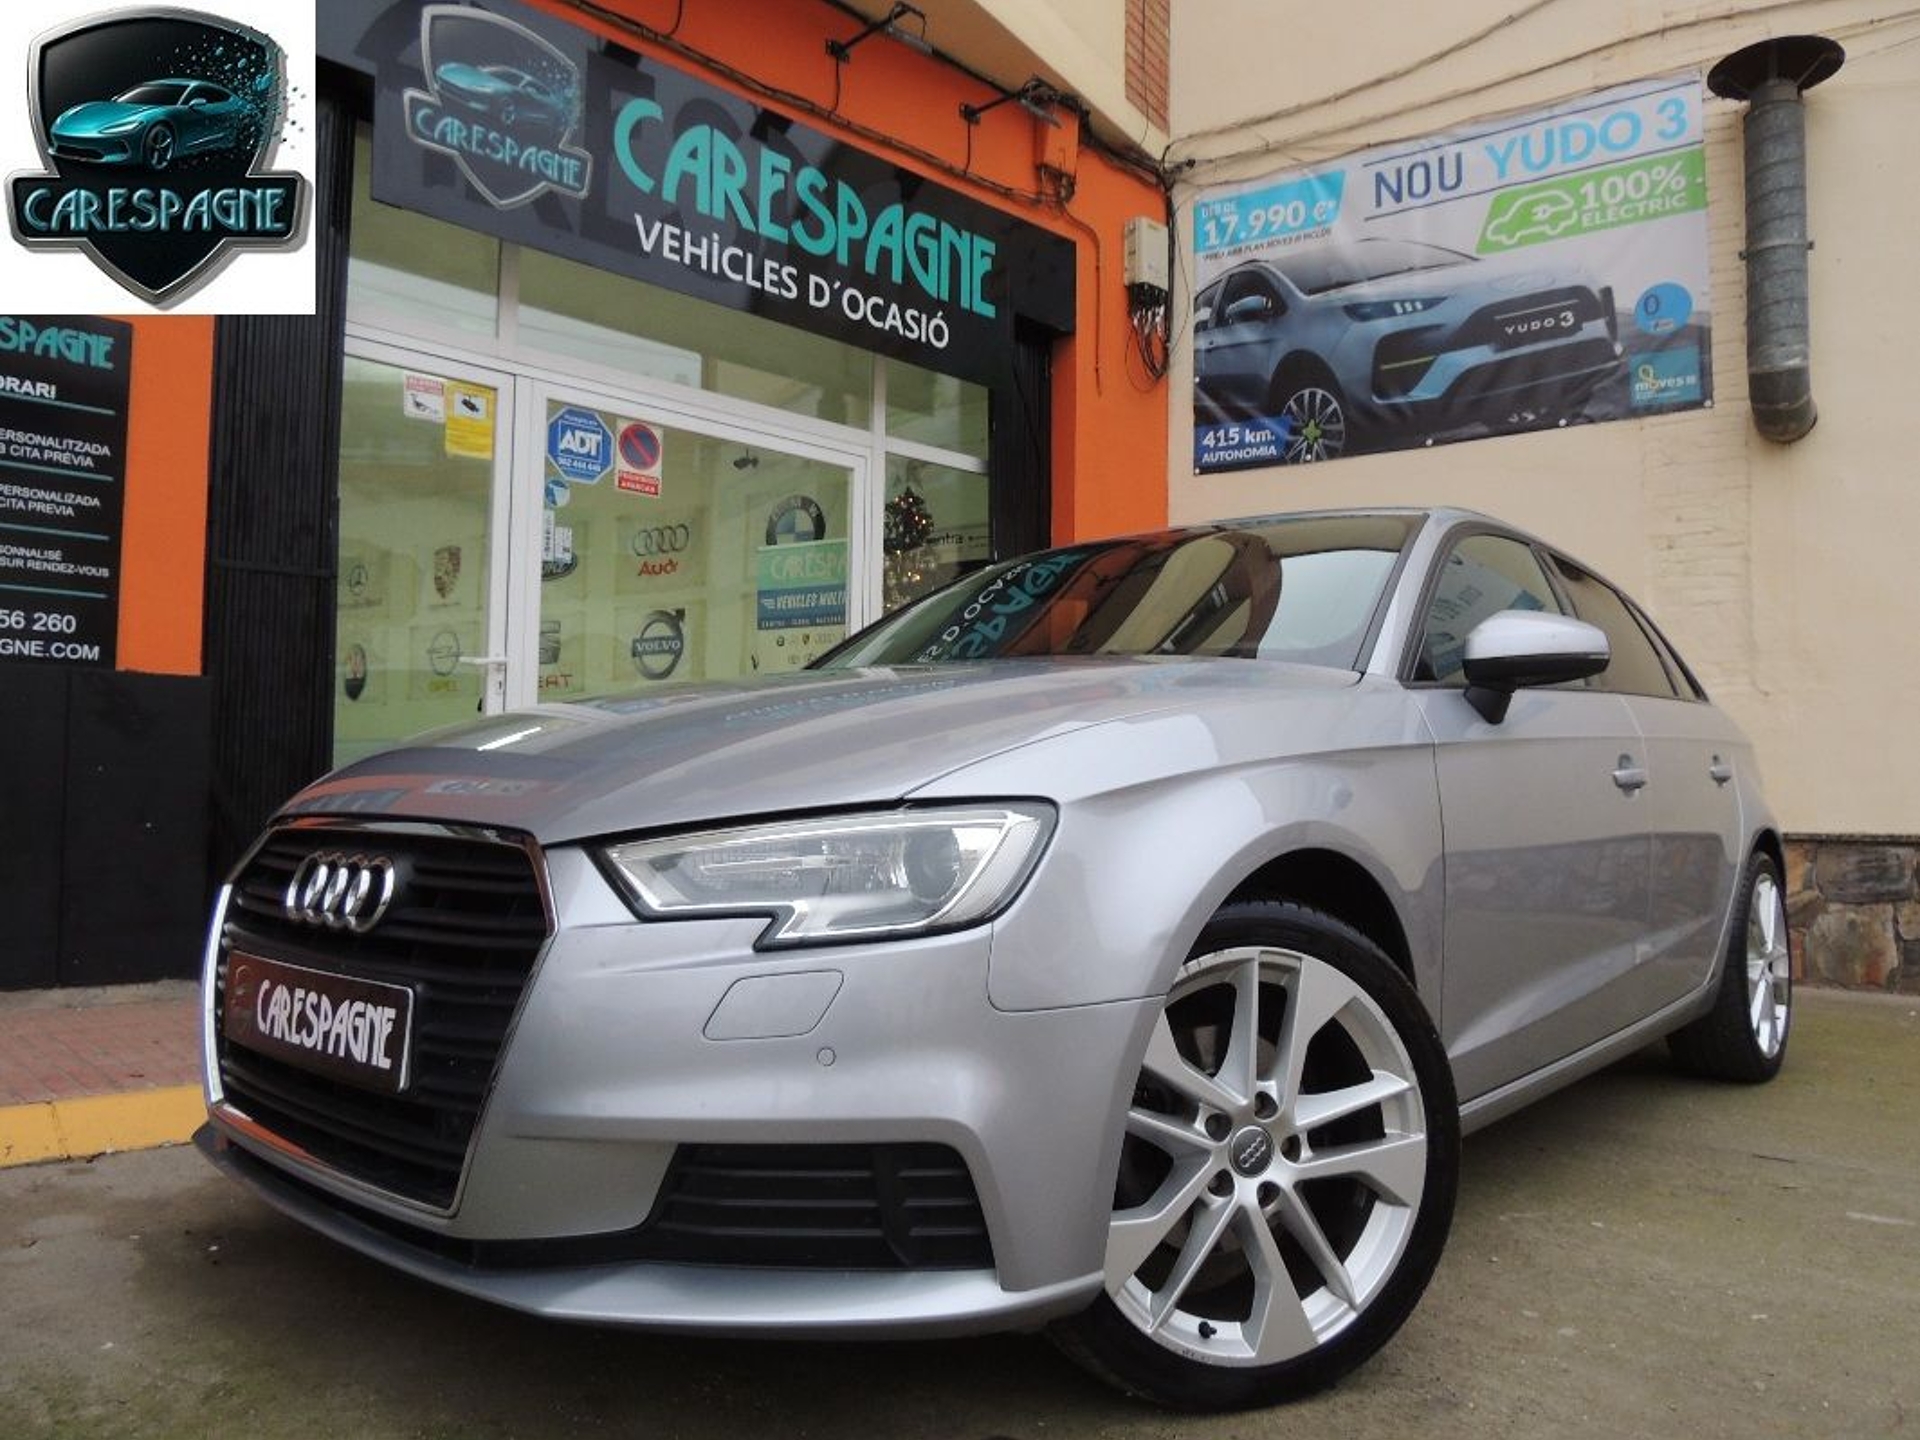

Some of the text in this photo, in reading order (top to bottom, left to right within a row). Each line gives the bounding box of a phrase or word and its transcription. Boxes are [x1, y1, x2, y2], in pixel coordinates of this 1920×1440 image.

[416, 107, 581, 189] CARESPAGNE
[1375, 97, 1688, 208] NOU YUDO 3
[1579, 160, 1687, 211] 100%
[613, 97, 998, 319] CARESPAGNE
[1204, 200, 1306, 246] 17.990
[1504, 310, 1575, 335] YUDO 3
[559, 428, 602, 456] ADT
[1202, 427, 1275, 448] 415 km.
[10, 444, 41, 460] CITA
[1201, 445, 1277, 463] AUTONOMIA
[28, 501, 75, 517] PREVIA
[27, 560, 110, 578] RENDEZ-VOUS
[32, 612, 77, 634] 260
[634, 638, 681, 652] VOLVO
[256, 979, 397, 1070] CARESPAGNE
